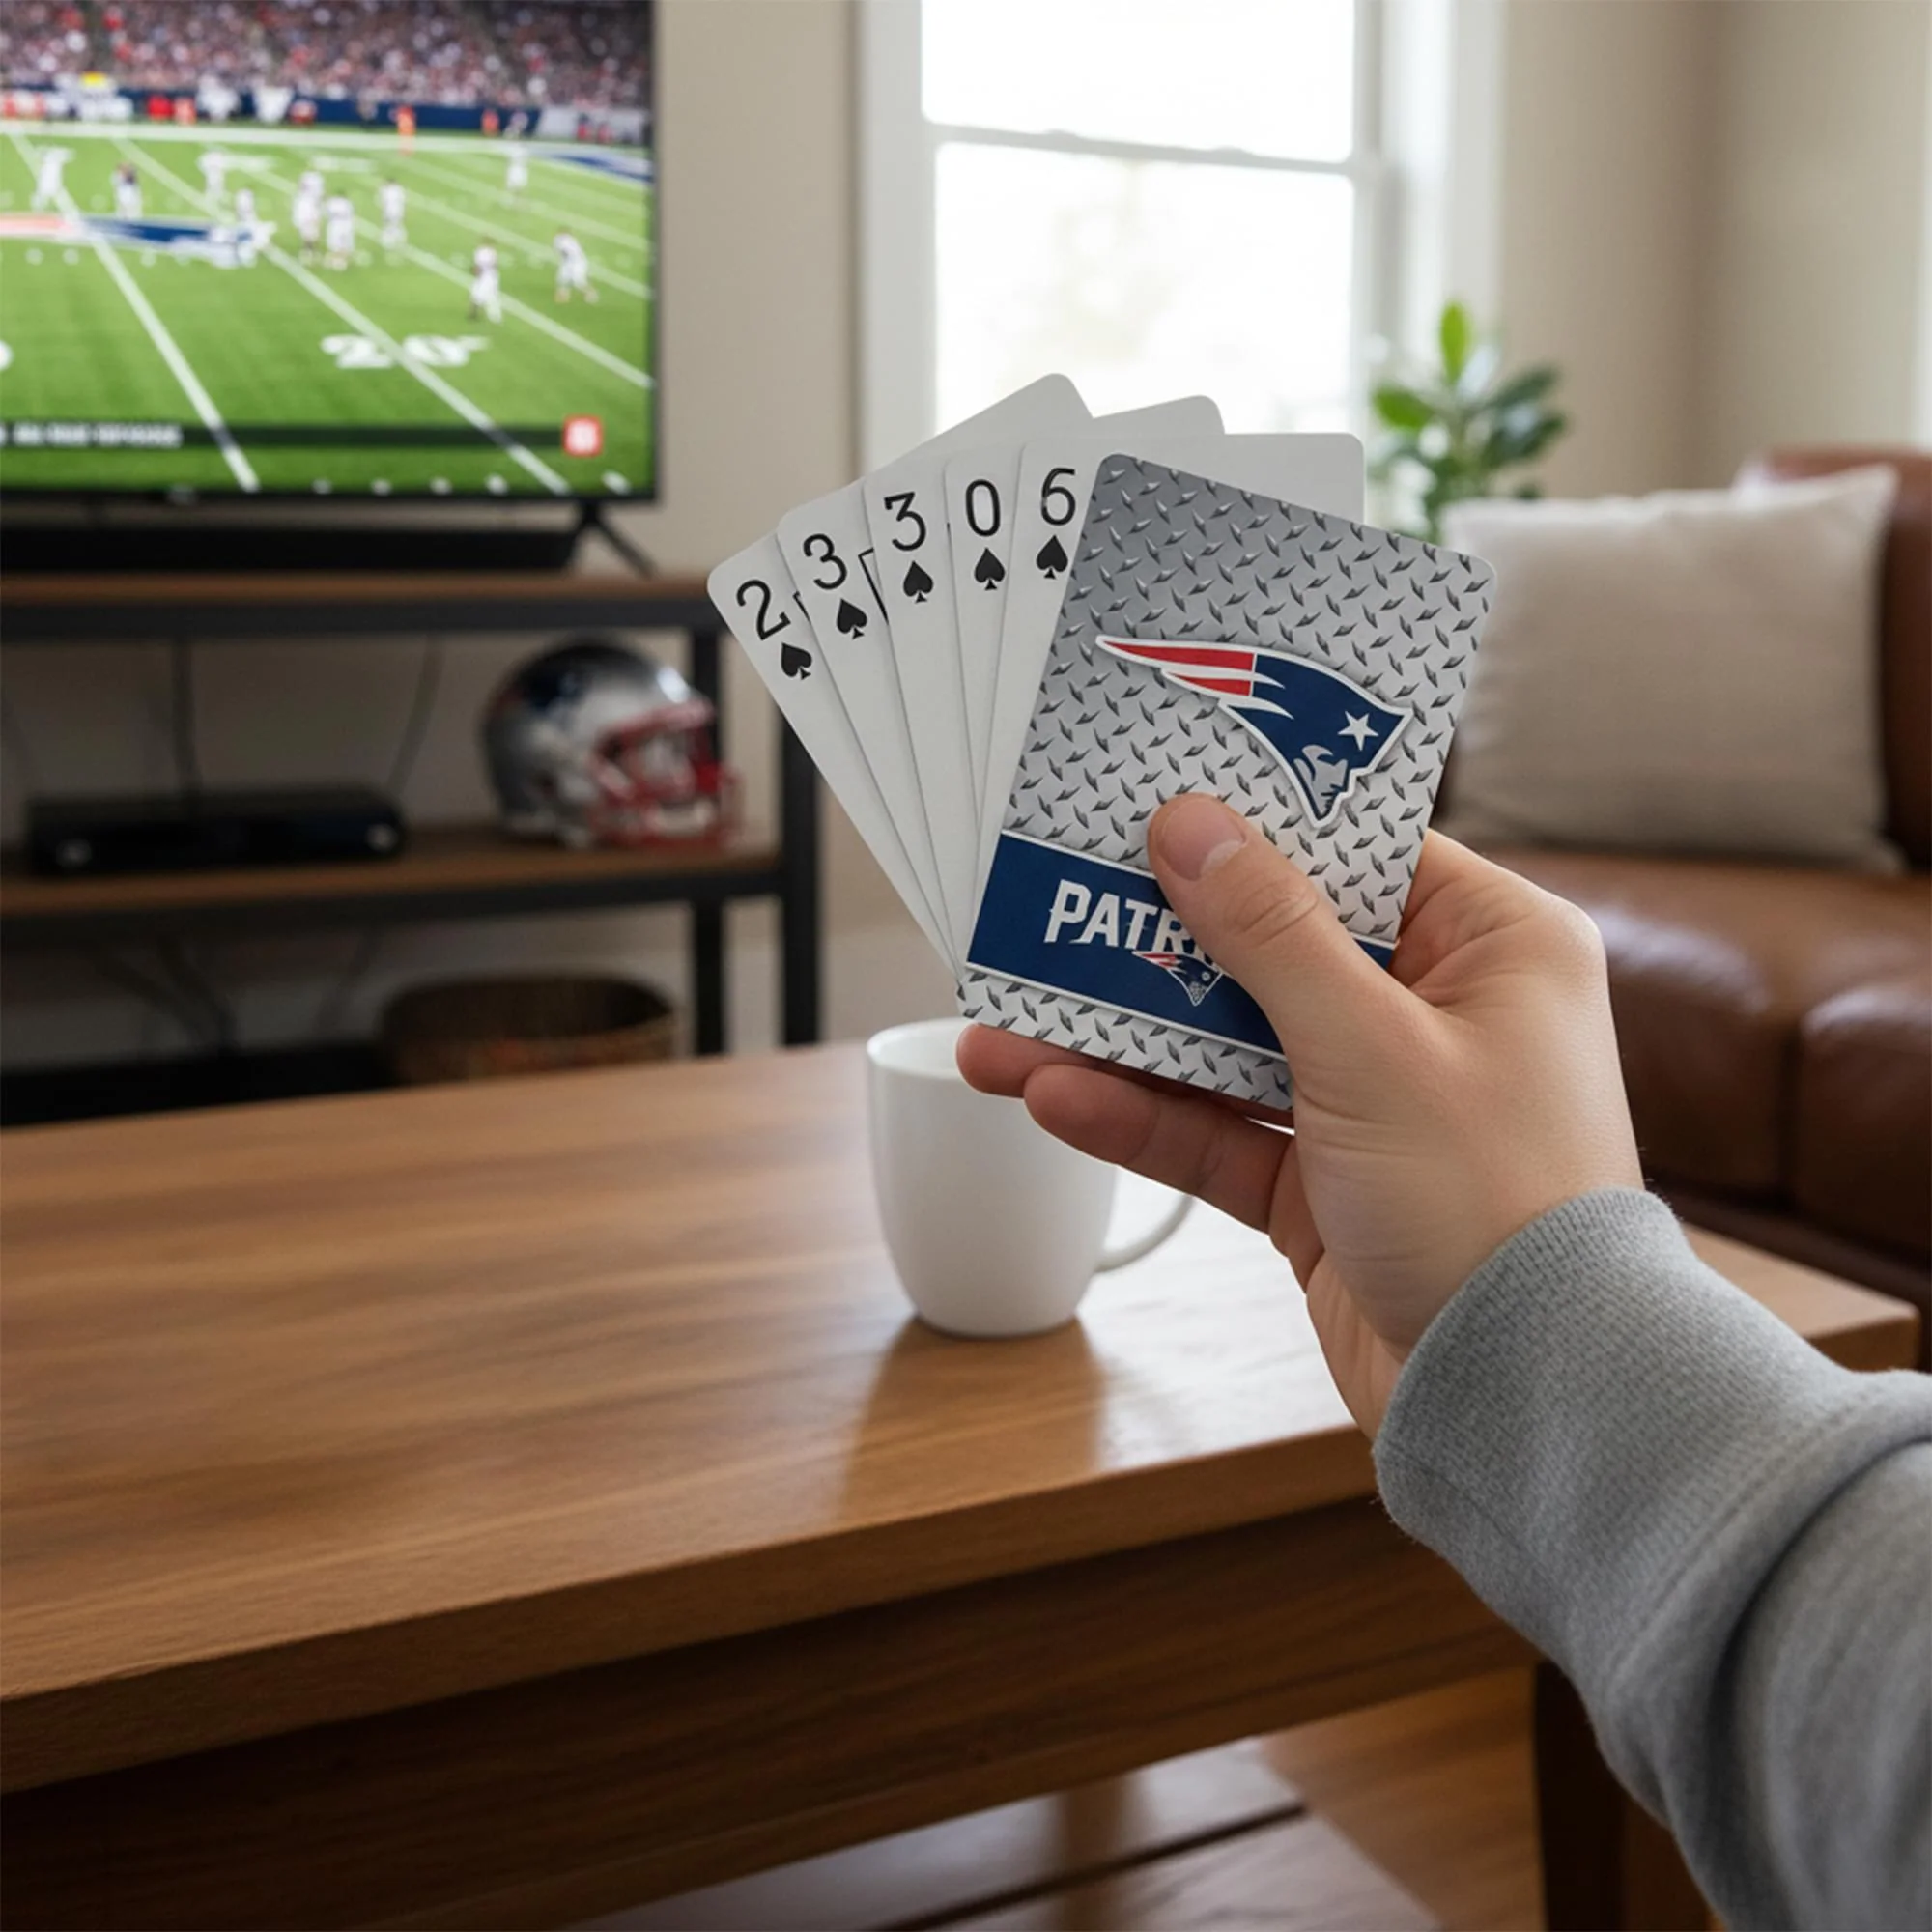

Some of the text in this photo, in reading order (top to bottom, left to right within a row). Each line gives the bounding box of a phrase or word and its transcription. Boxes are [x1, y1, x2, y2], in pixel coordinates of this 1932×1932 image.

[883, 491, 926, 552] 3
[965, 479, 1001, 537] 0
[1040, 467, 1076, 526] 6
[803, 533, 848, 590] 3
[736, 579, 791, 640] 2
[1044, 879, 1213, 966] PATR
